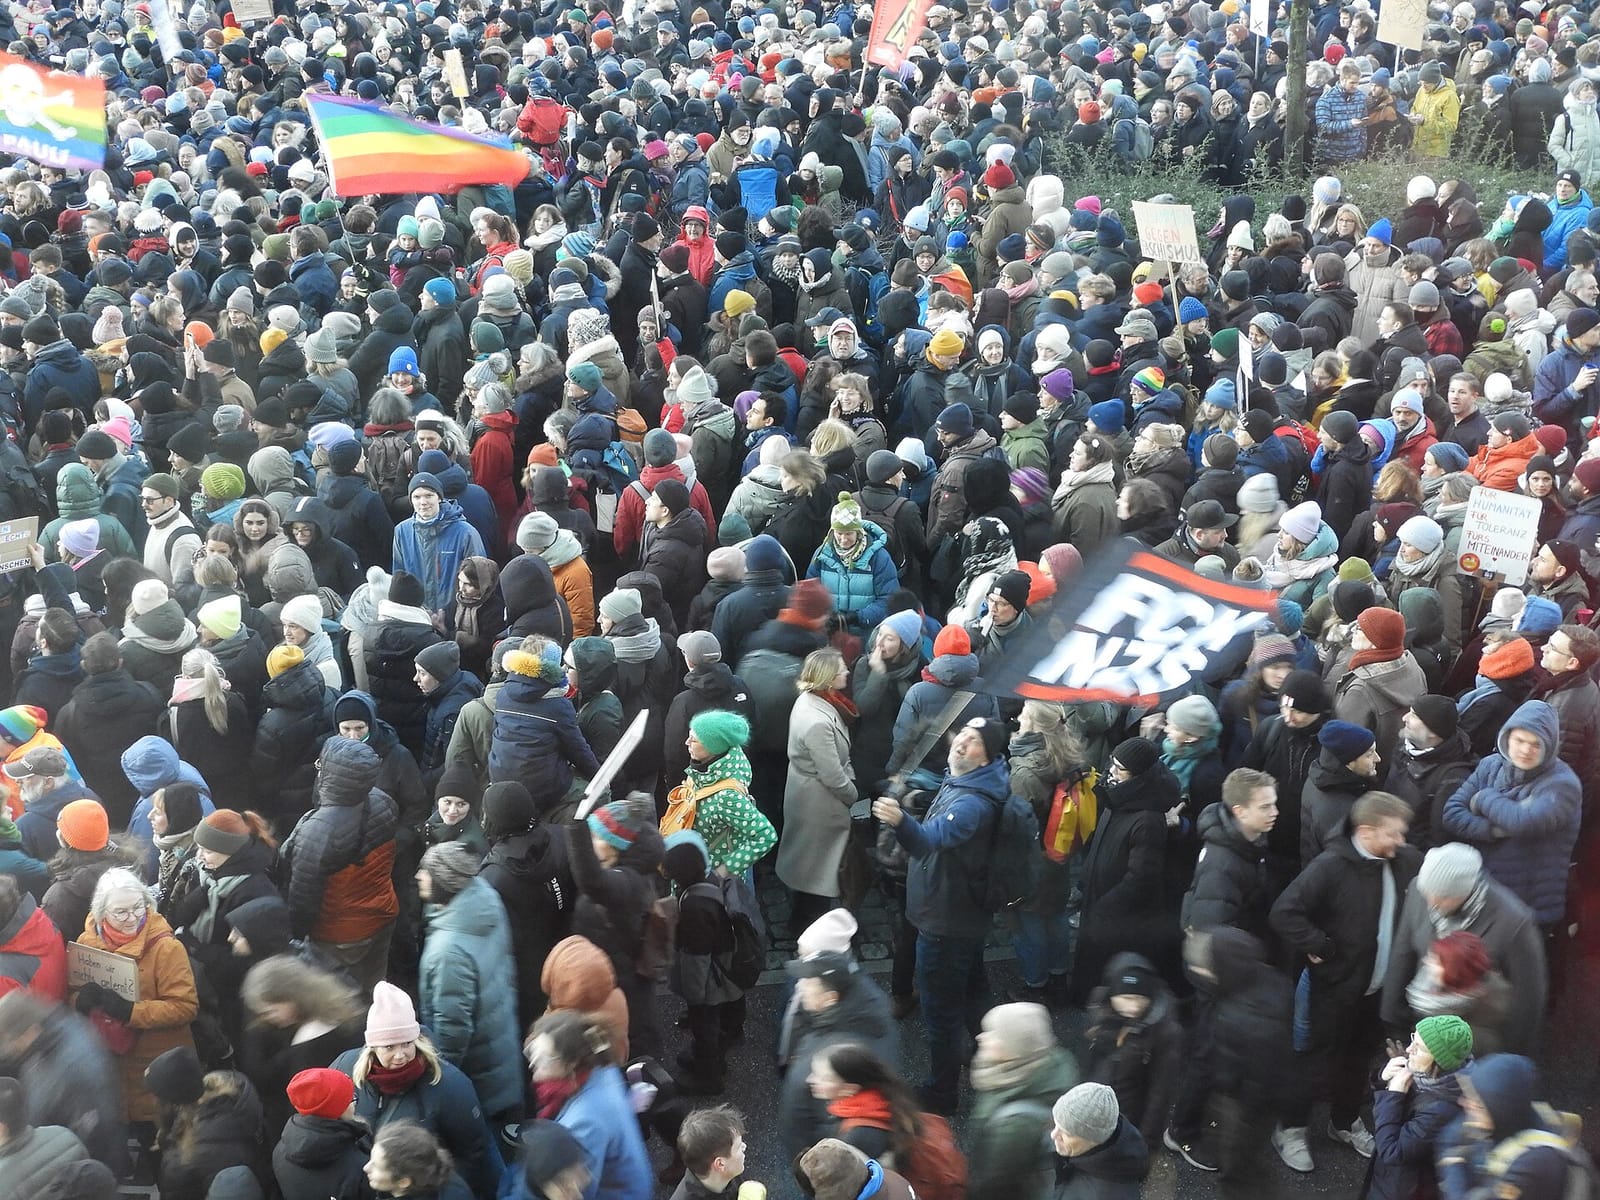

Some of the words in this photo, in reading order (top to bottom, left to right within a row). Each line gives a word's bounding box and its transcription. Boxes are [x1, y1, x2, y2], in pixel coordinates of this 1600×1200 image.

[1476, 521, 1528, 538] TOLERANZ
[1467, 540, 1529, 561] MITEINANDER
[1075, 573, 1269, 652] FCK
